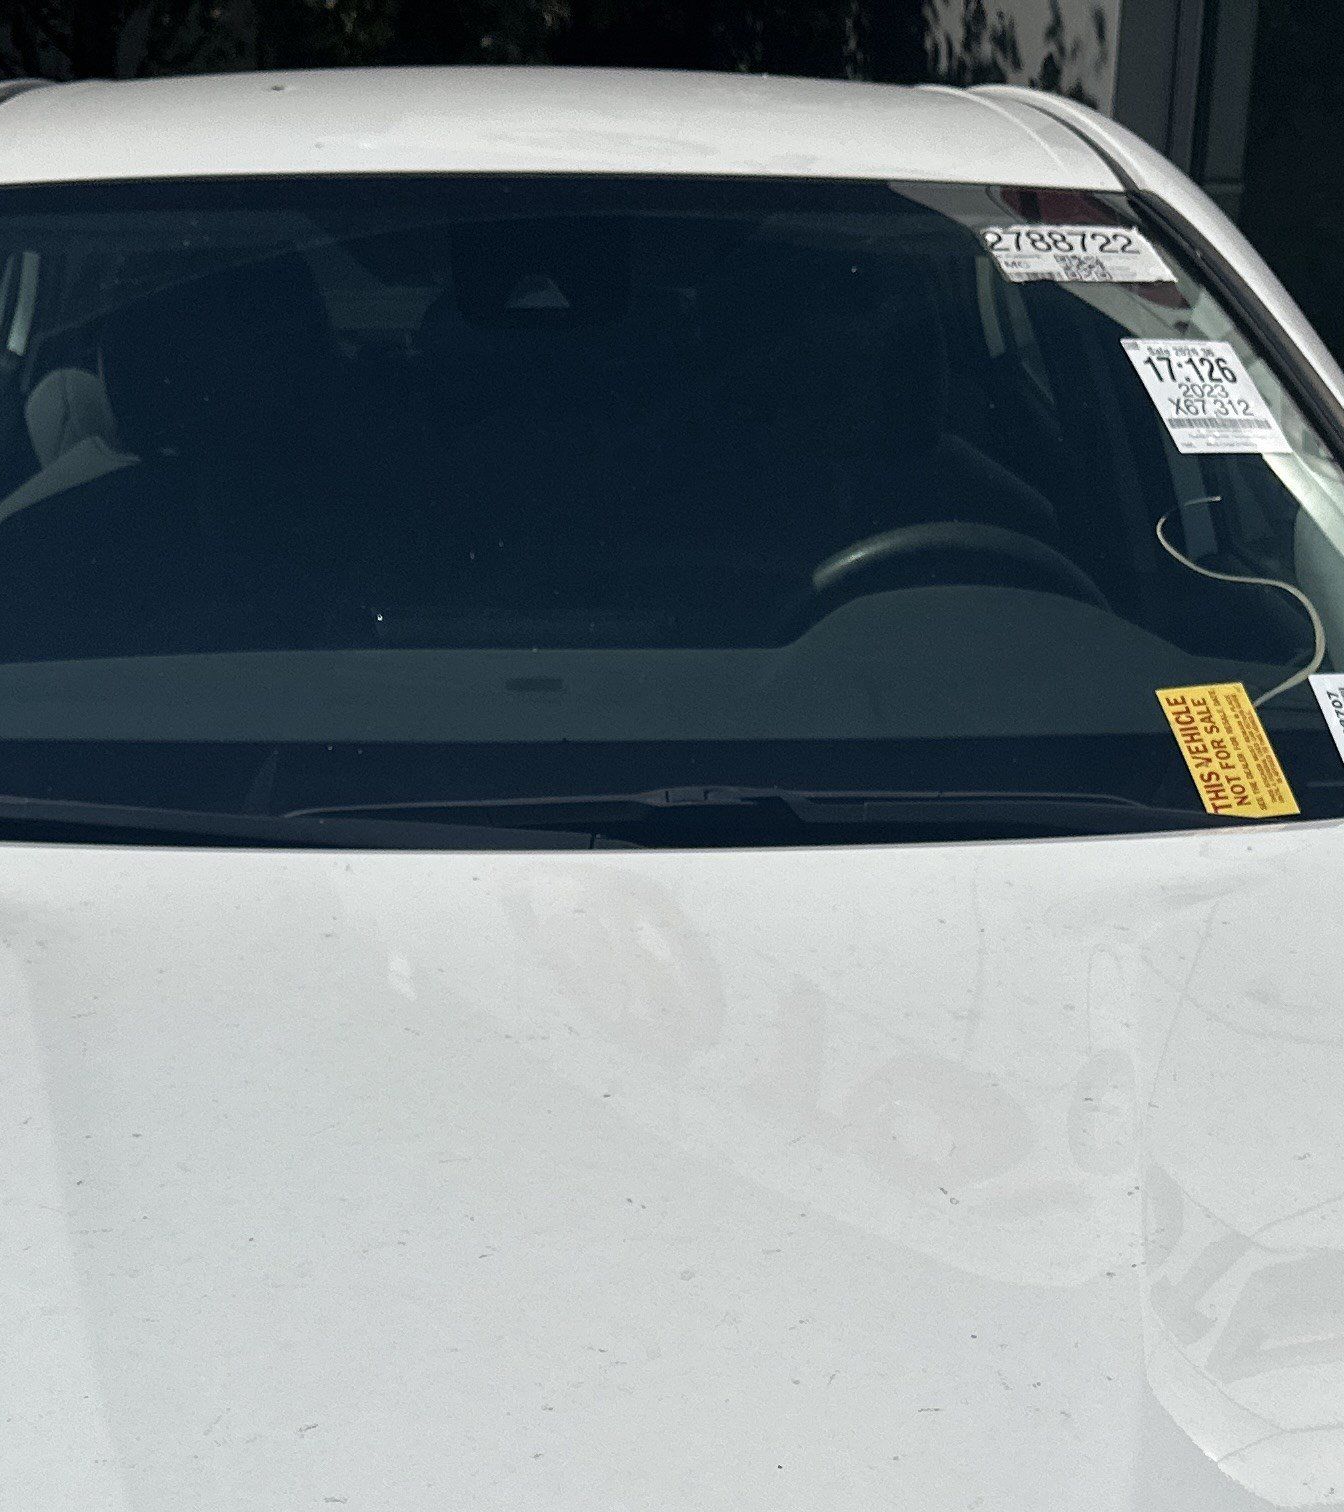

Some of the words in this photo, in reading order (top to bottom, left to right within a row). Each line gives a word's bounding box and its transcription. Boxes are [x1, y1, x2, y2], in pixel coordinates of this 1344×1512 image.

[982, 230, 1141, 255] 2788722
[1143, 356, 1237, 383] 17:126
[1178, 383, 1229, 399] 2023
[1165, 695, 1213, 769] VEHICLE
[1191, 697, 1220, 735] SALE
[1210, 738, 1236, 770] FOR
[1199, 770, 1233, 814] THIS
[1225, 774, 1252, 807] NOT
